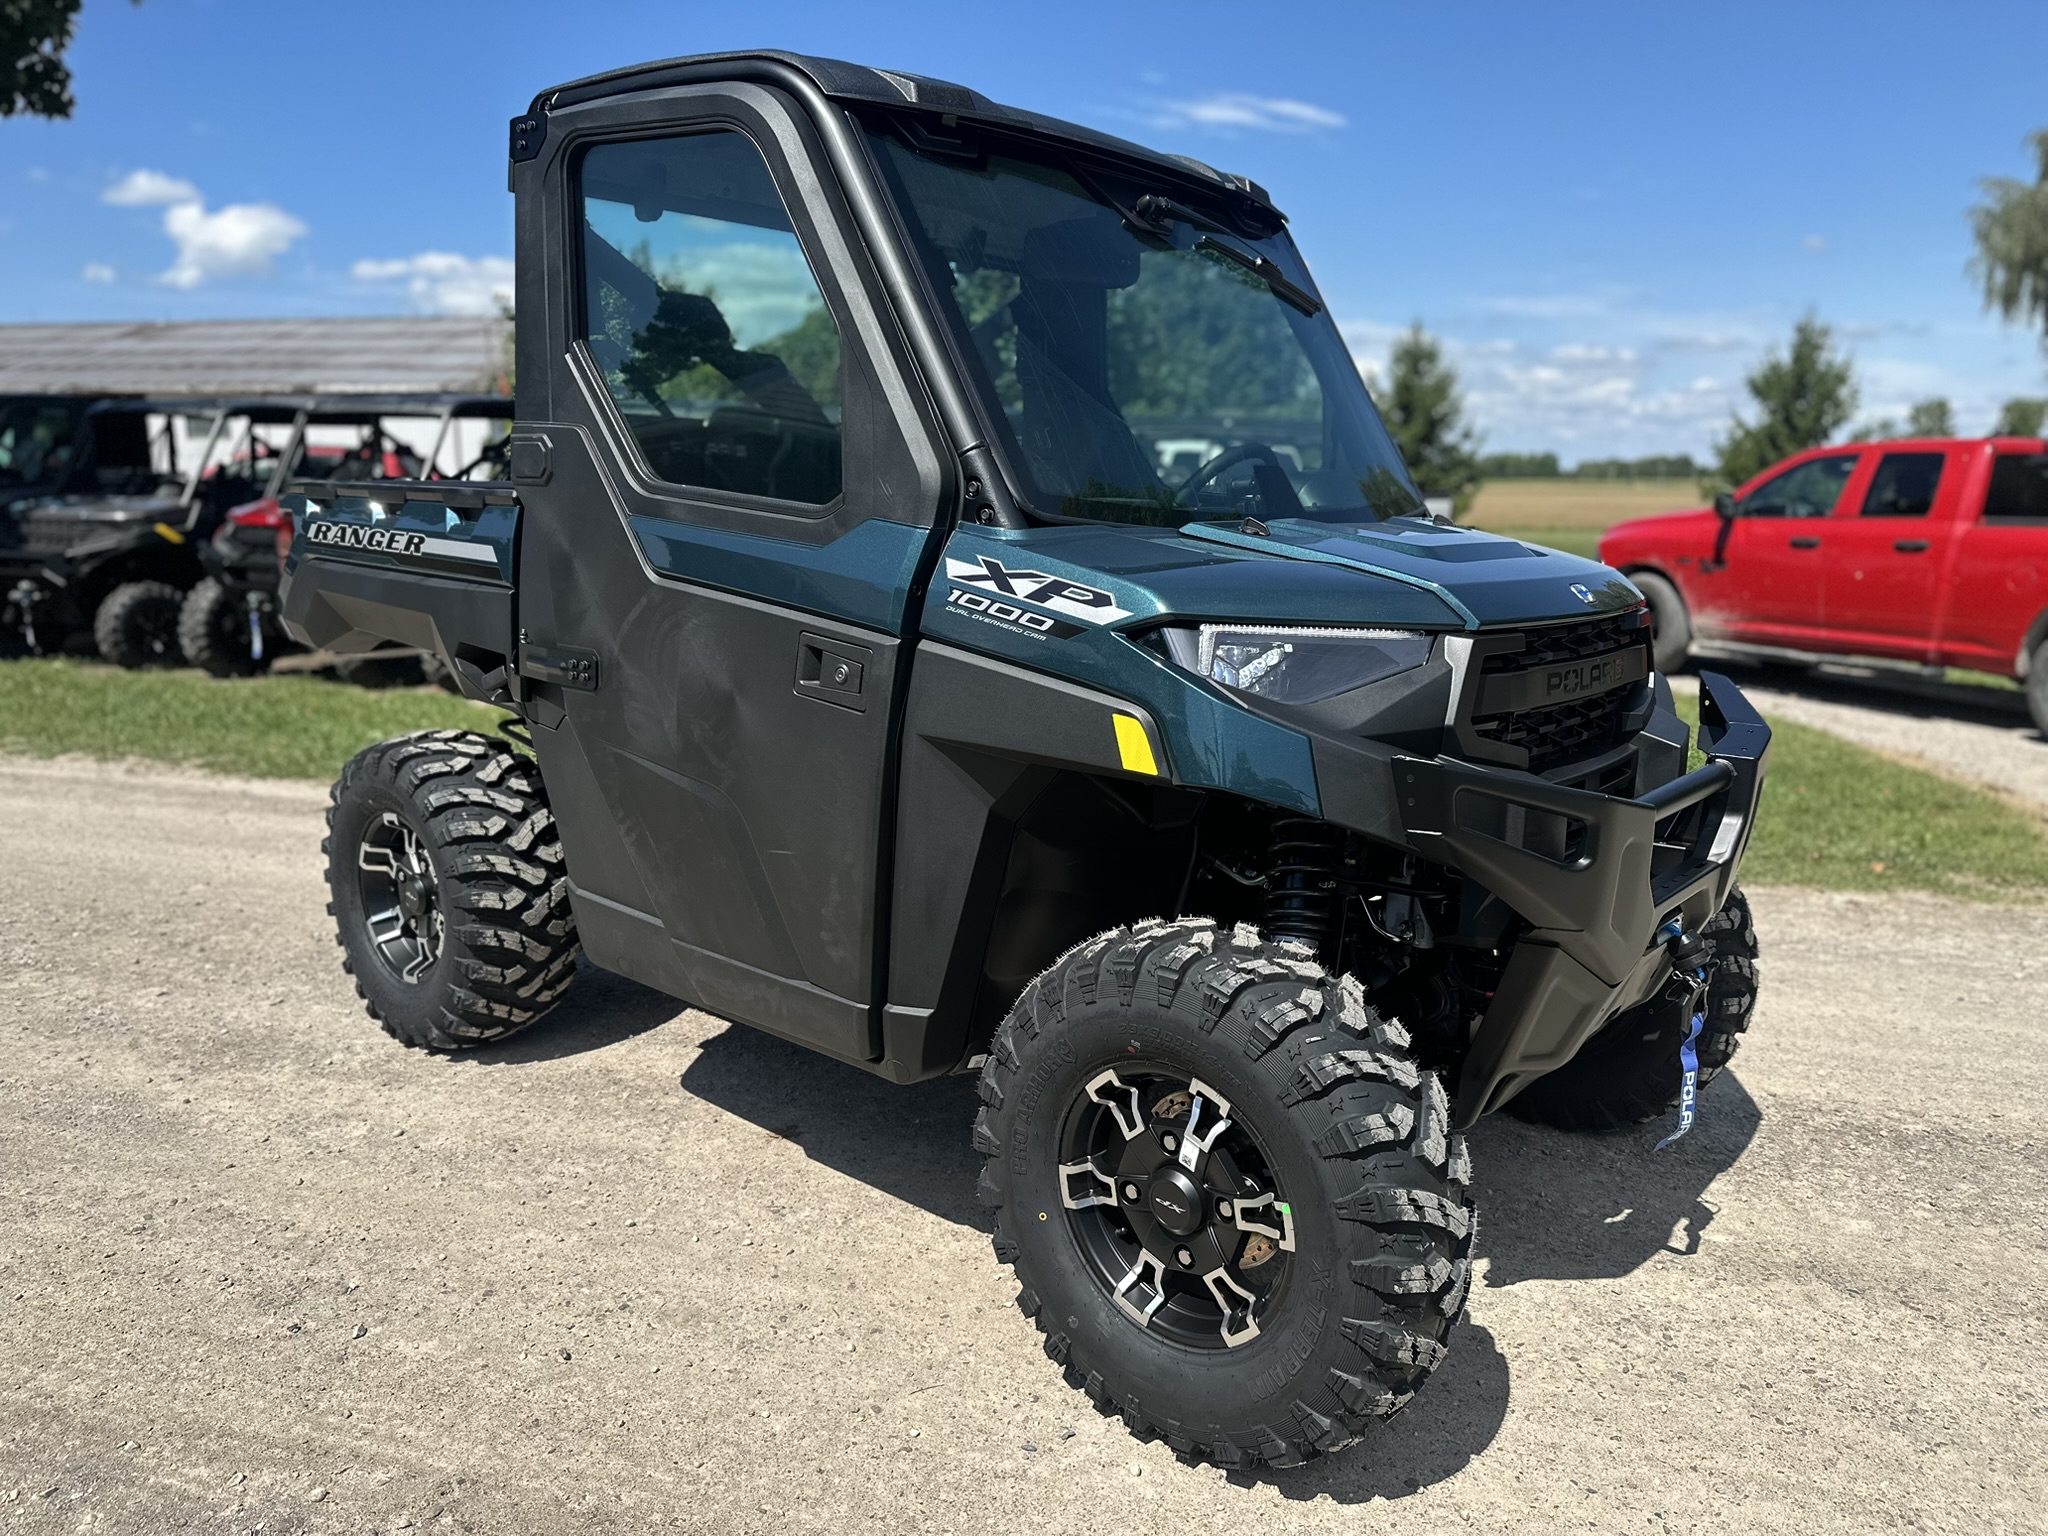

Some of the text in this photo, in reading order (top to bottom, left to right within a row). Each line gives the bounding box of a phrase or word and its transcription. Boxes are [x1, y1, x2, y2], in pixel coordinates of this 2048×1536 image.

[312, 521, 426, 556] RANGER
[949, 555, 1116, 608] XP
[945, 605, 1047, 641] DUAL OVERHEAD CAM
[947, 589, 1054, 631] 1000
[1547, 657, 1624, 697] POLARIS
[1011, 1054, 1063, 1177] PRO ARMOR
[1247, 1257, 1331, 1403] X-TERRAIN
